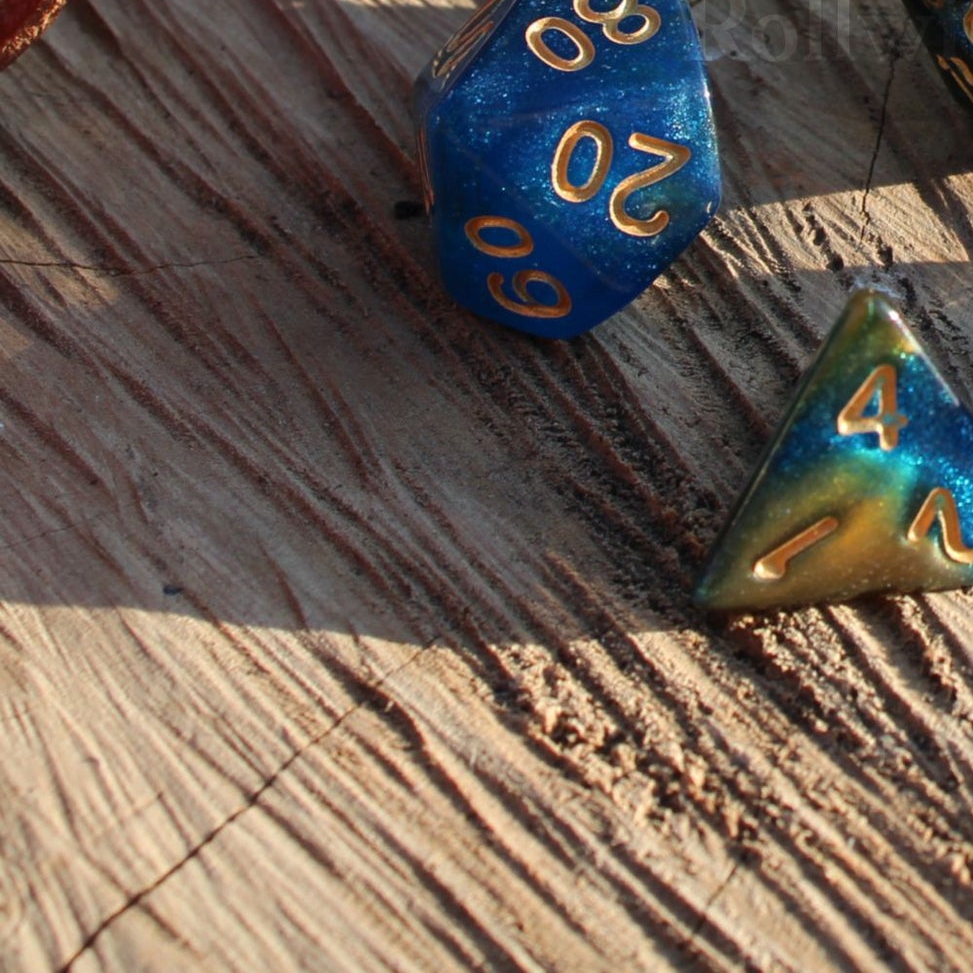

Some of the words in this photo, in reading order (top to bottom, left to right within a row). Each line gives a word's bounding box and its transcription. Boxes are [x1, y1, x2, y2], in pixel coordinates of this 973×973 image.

[551, 119, 691, 237] 20
[837, 364, 909, 451] 4
[753, 517, 838, 579] 1
